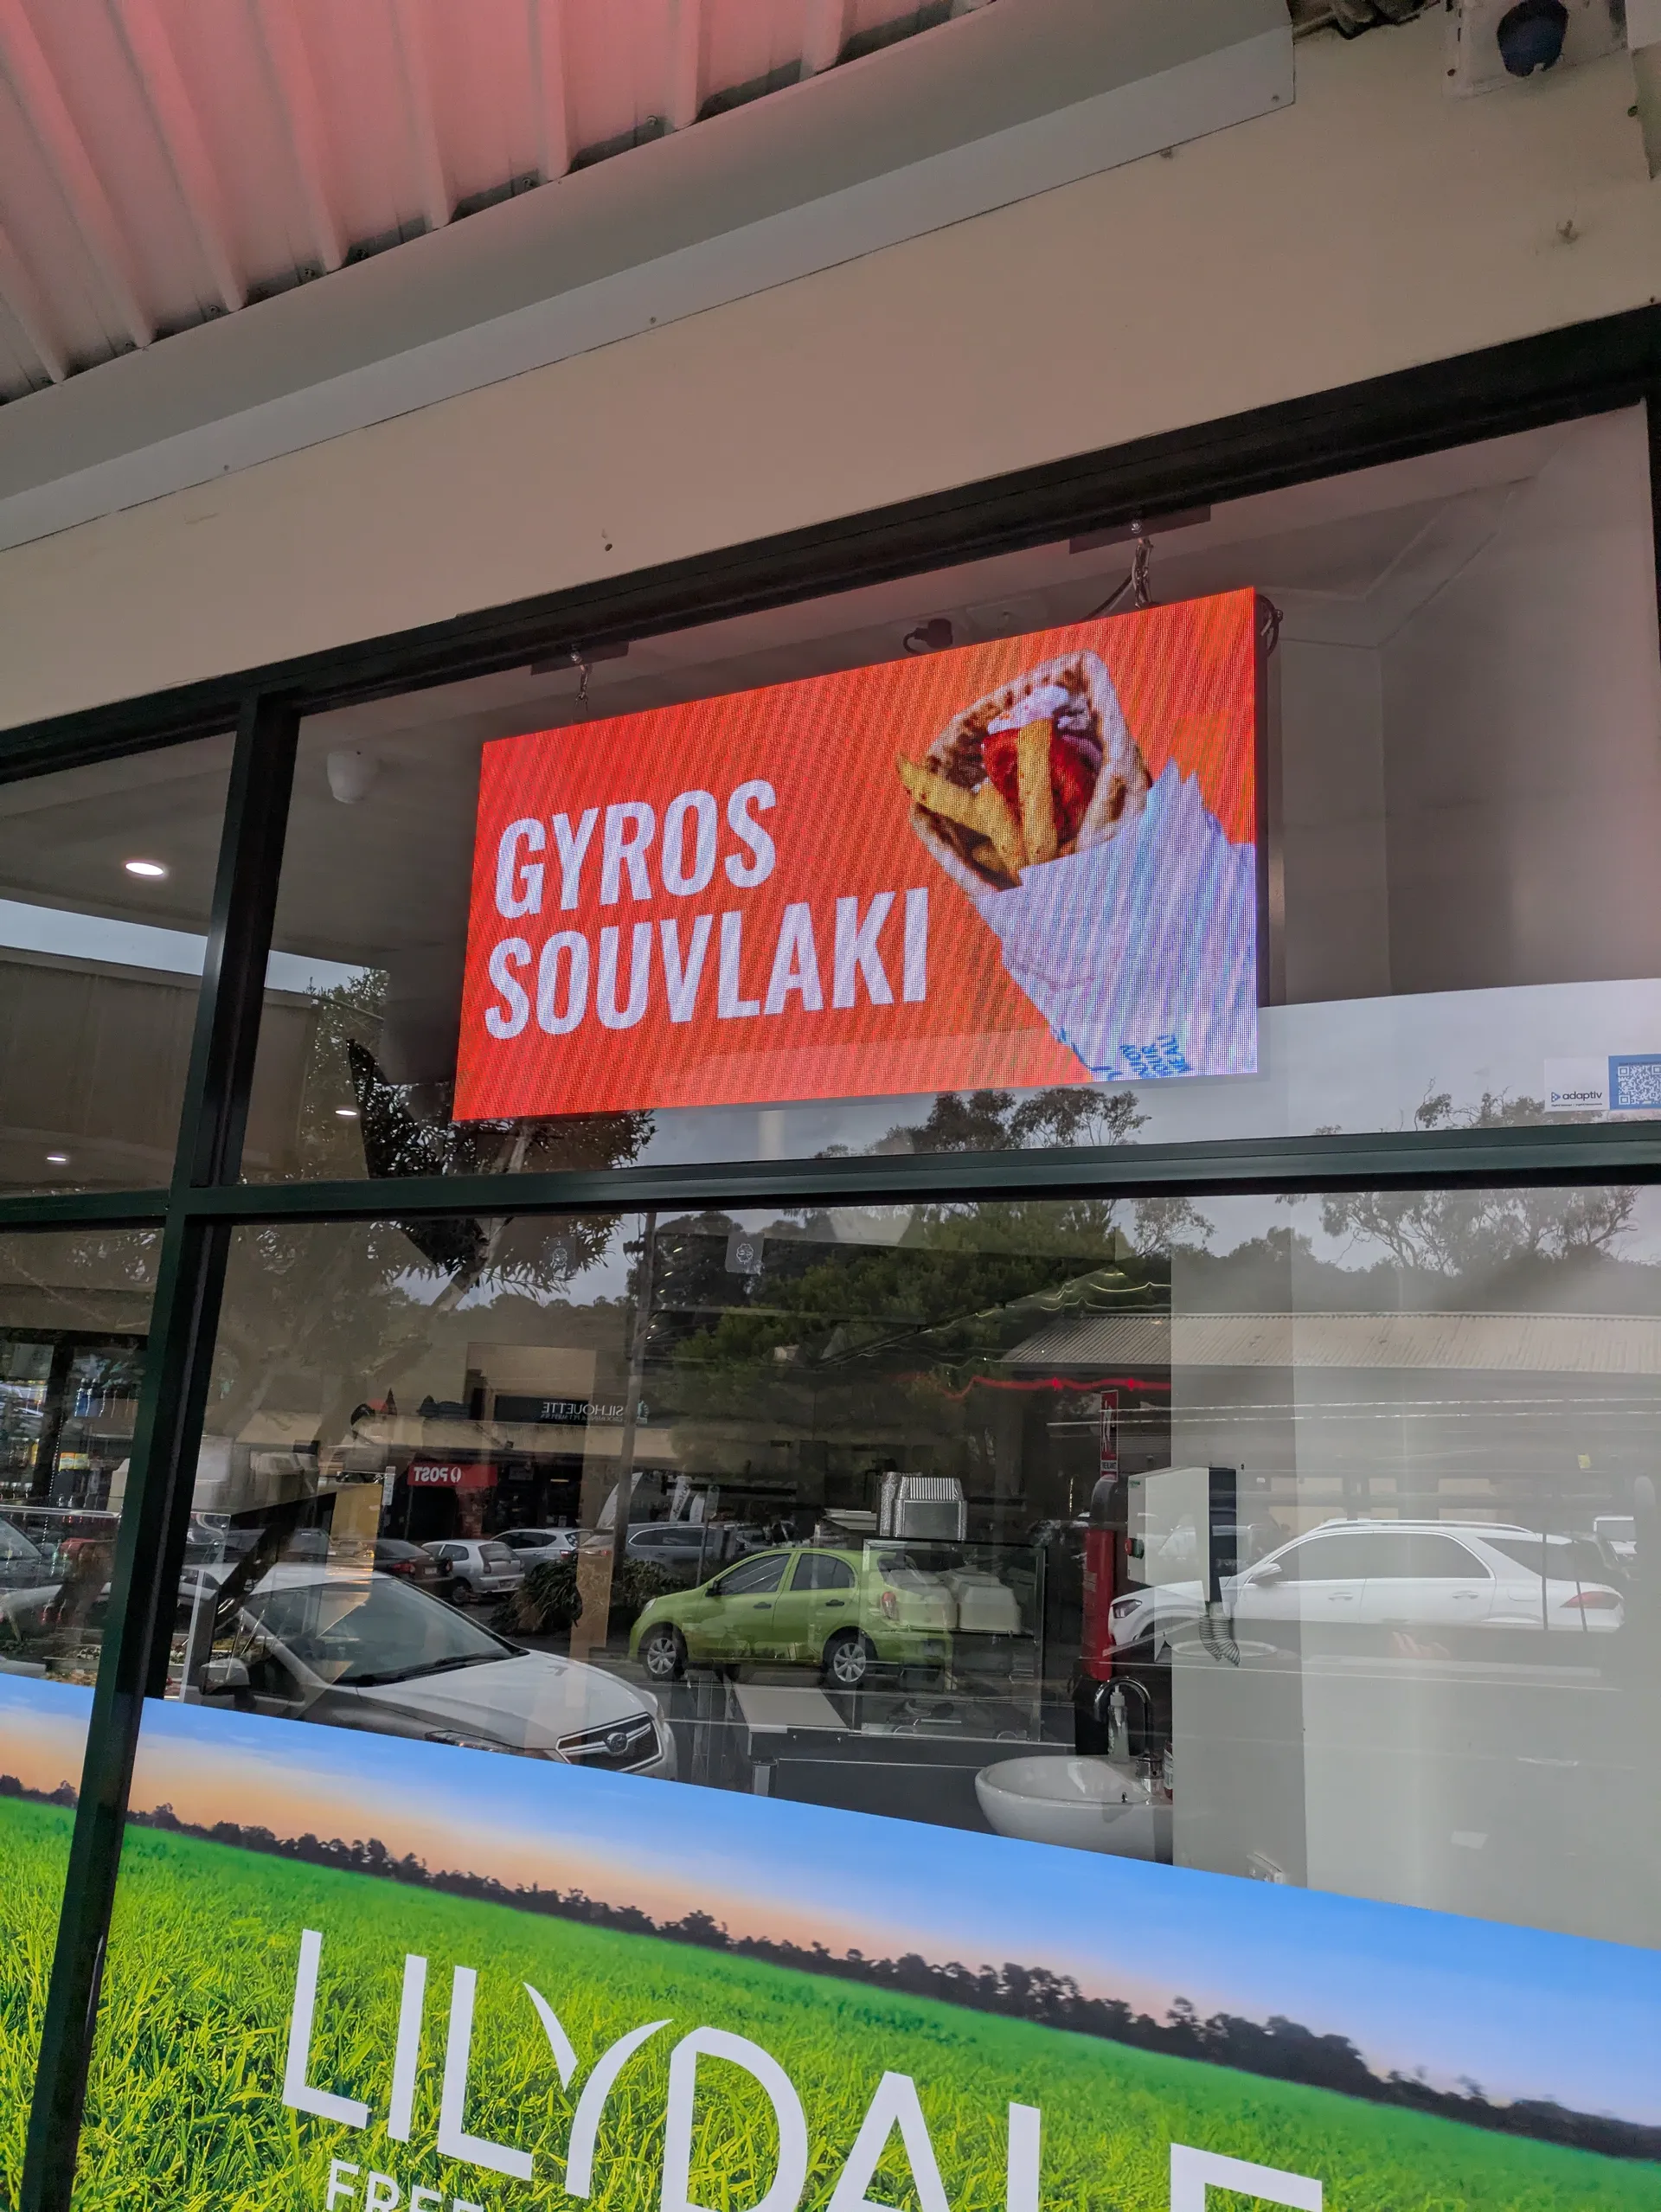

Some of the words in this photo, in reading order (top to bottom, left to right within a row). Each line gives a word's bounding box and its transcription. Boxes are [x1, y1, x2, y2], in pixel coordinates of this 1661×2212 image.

[495, 779, 776, 919] GYROS
[484, 887, 928, 1040] SOUVLAKI
[1562, 1091, 1603, 1101] adaptiv
[325, 2158, 484, 2212] FRE
